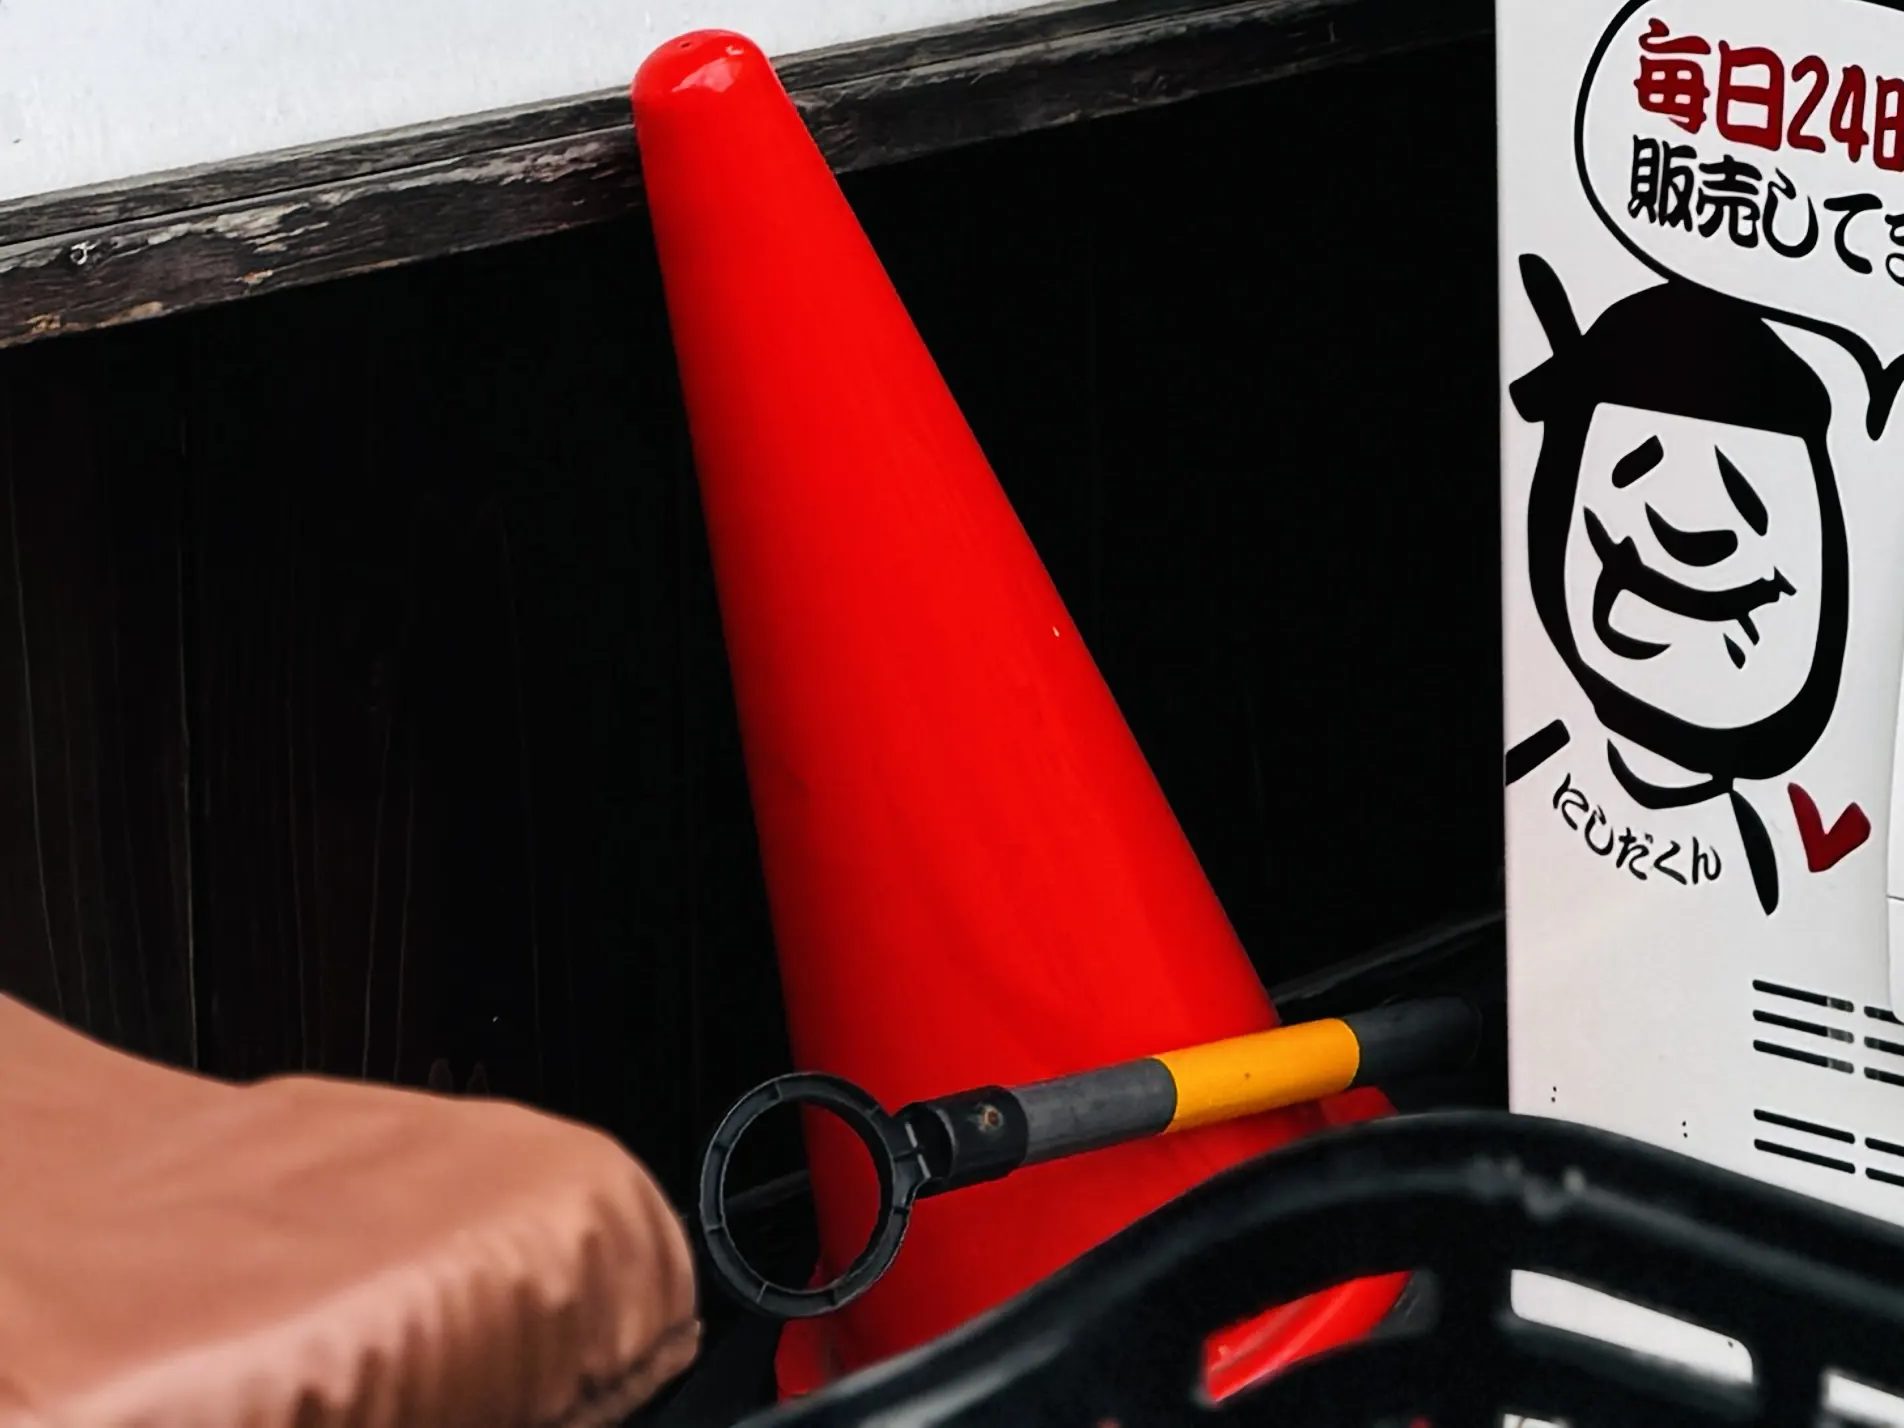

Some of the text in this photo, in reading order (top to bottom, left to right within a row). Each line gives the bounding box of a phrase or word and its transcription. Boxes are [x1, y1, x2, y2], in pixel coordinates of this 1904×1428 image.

[1552, 772, 1722, 886] にしだくん
